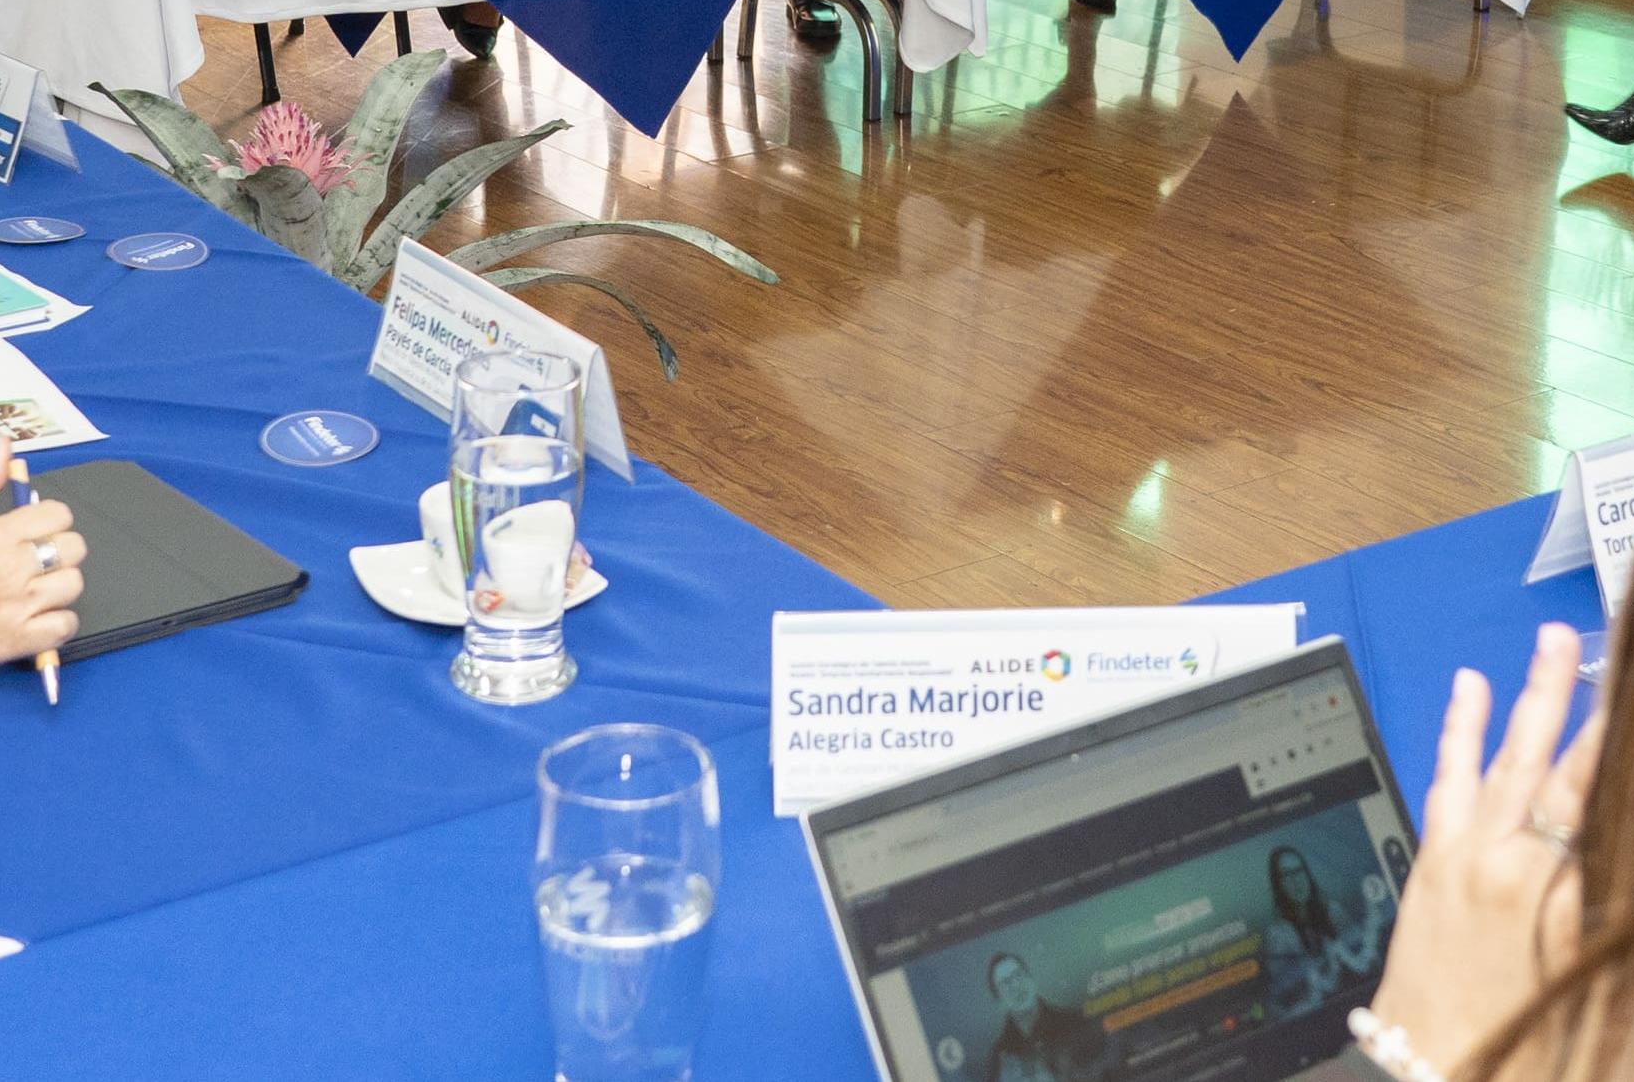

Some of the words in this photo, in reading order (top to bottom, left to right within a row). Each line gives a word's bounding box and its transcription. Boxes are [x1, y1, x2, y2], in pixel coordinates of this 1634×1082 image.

[392, 295, 427, 332] Felipa
[461, 310, 486, 333] ALIDE
[413, 340, 423, 357] de
[971, 658, 1034, 674] ALIDE
[1087, 652, 1173, 673] Findeter
[789, 687, 896, 716] Sandra
[909, 685, 1044, 718] Marjorie
[881, 728, 954, 749] Castro
